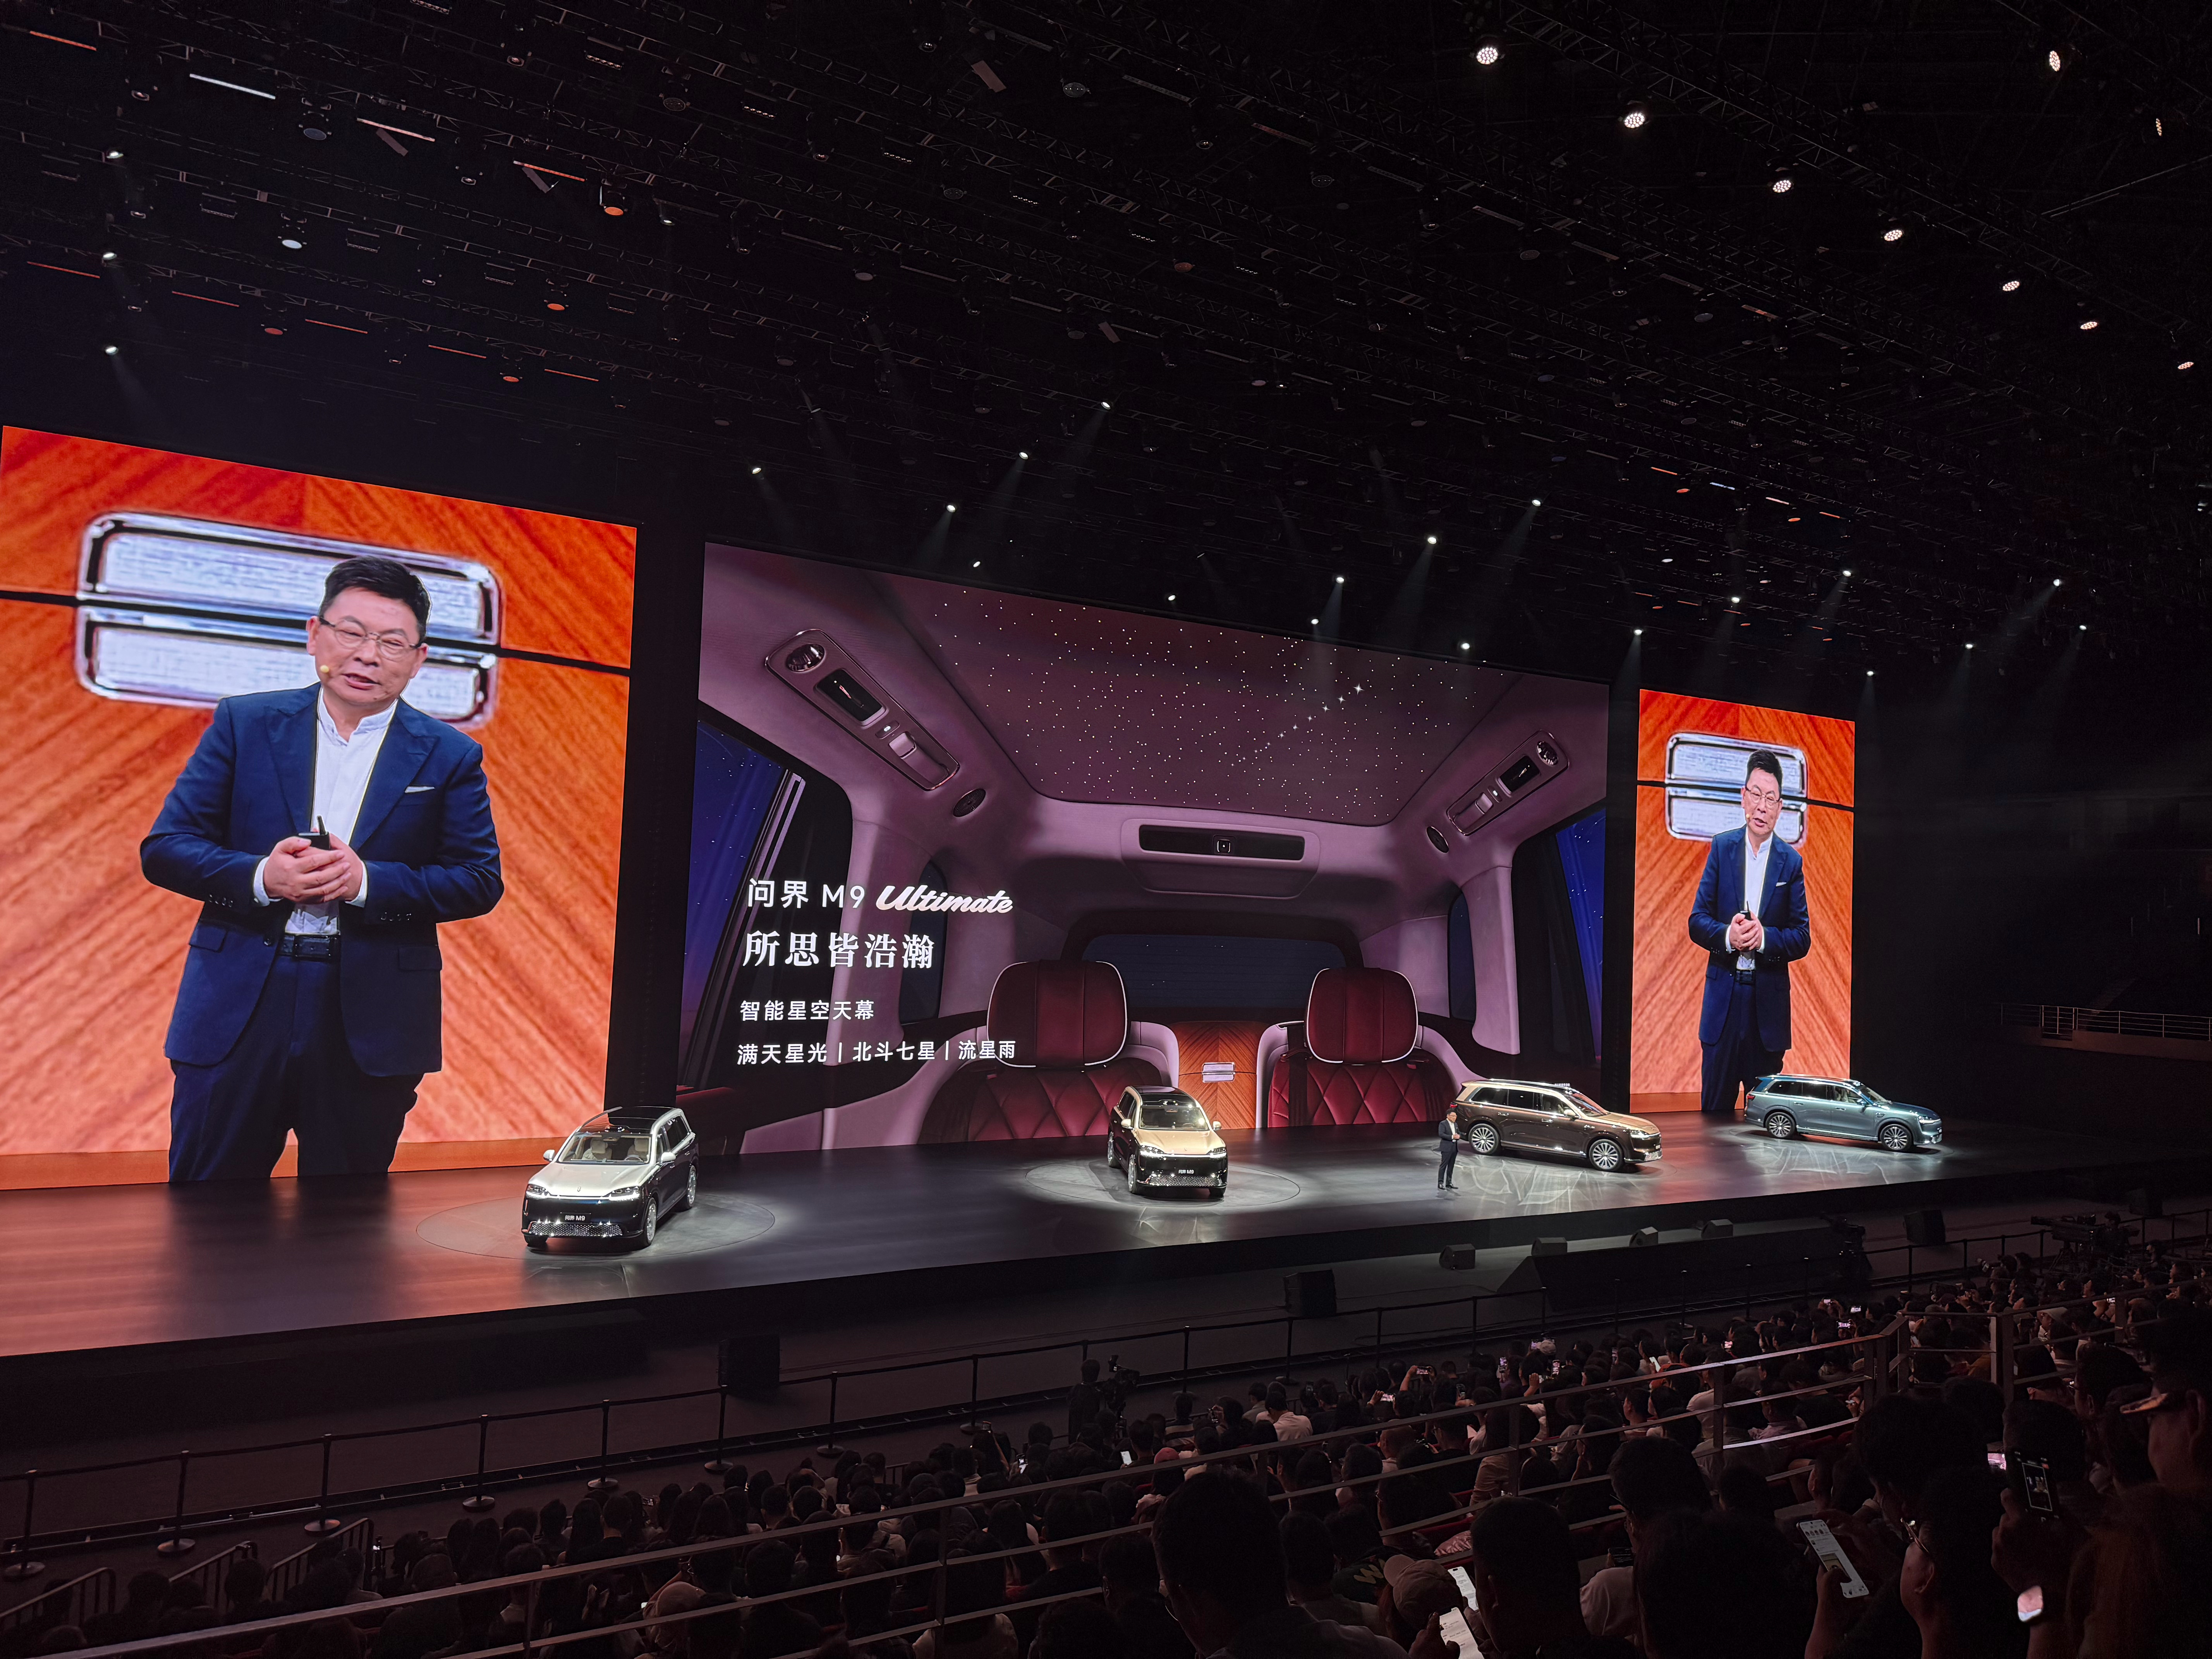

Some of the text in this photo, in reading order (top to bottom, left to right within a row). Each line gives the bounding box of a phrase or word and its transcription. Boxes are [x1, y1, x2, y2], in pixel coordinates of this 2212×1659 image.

[748, 878, 1013, 914] 问界 M9 Ultimate
[743, 930, 935, 969] 所思皆浩瀚
[740, 1000, 874, 1022] 智能星空天幕
[737, 1042, 828, 1065] 满天星光
[852, 1041, 935, 1062] 北斗七星
[958, 1039, 1016, 1060] 流星雨
